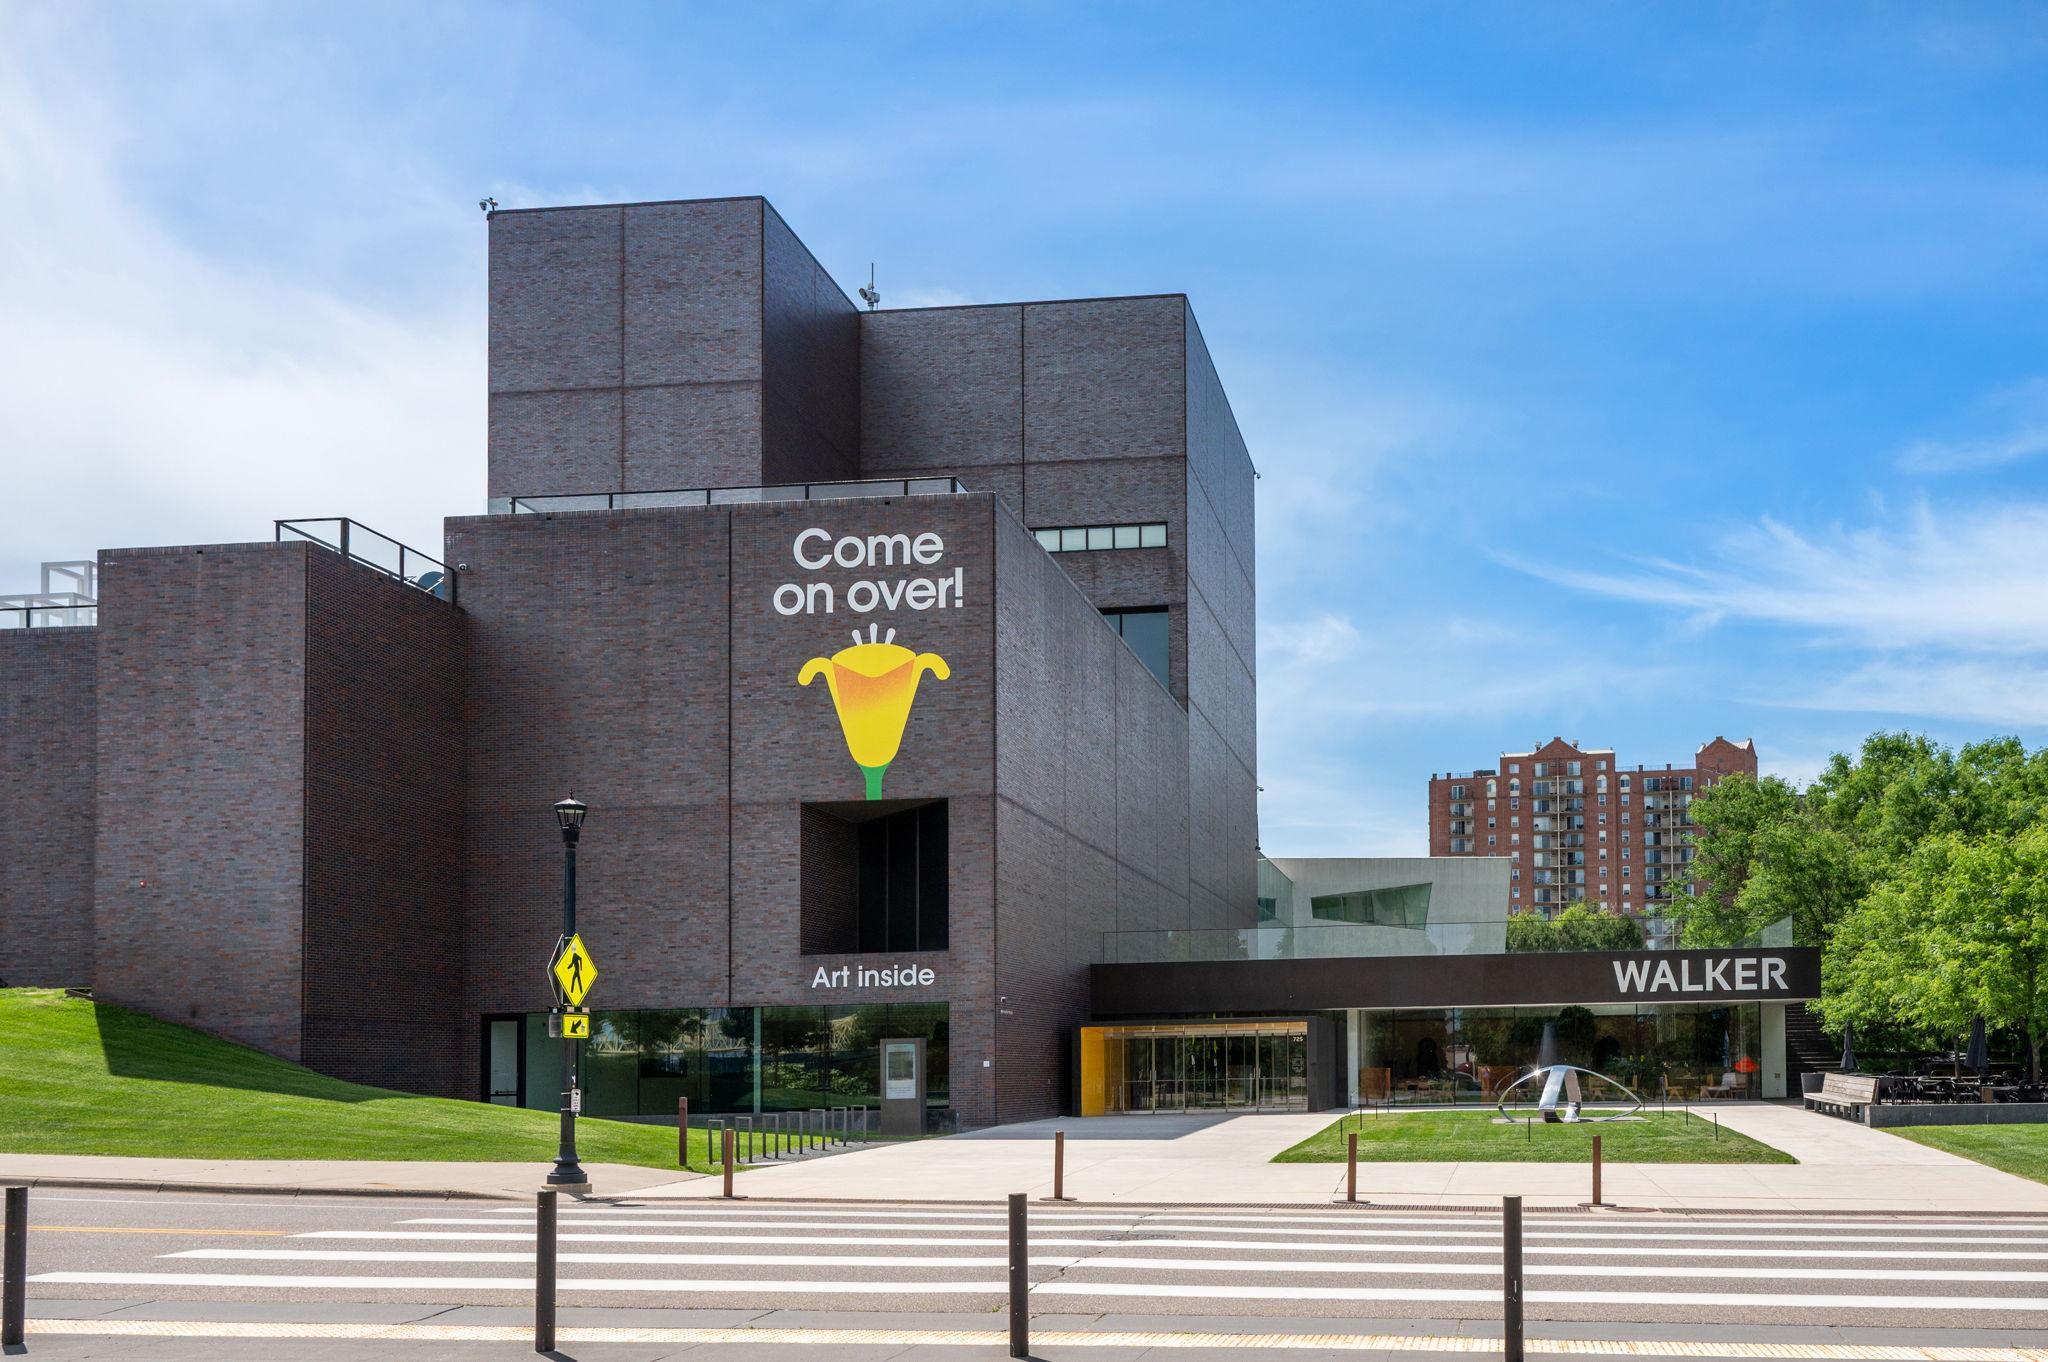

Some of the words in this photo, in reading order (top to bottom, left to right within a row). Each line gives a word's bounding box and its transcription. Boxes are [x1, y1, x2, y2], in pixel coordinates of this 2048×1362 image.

[794, 528, 943, 569] Come
[773, 583, 833, 615] on
[847, 567, 963, 612] over!
[812, 966, 850, 988] Art
[859, 964, 935, 987] inside
[1613, 957, 1788, 992] WALKER
